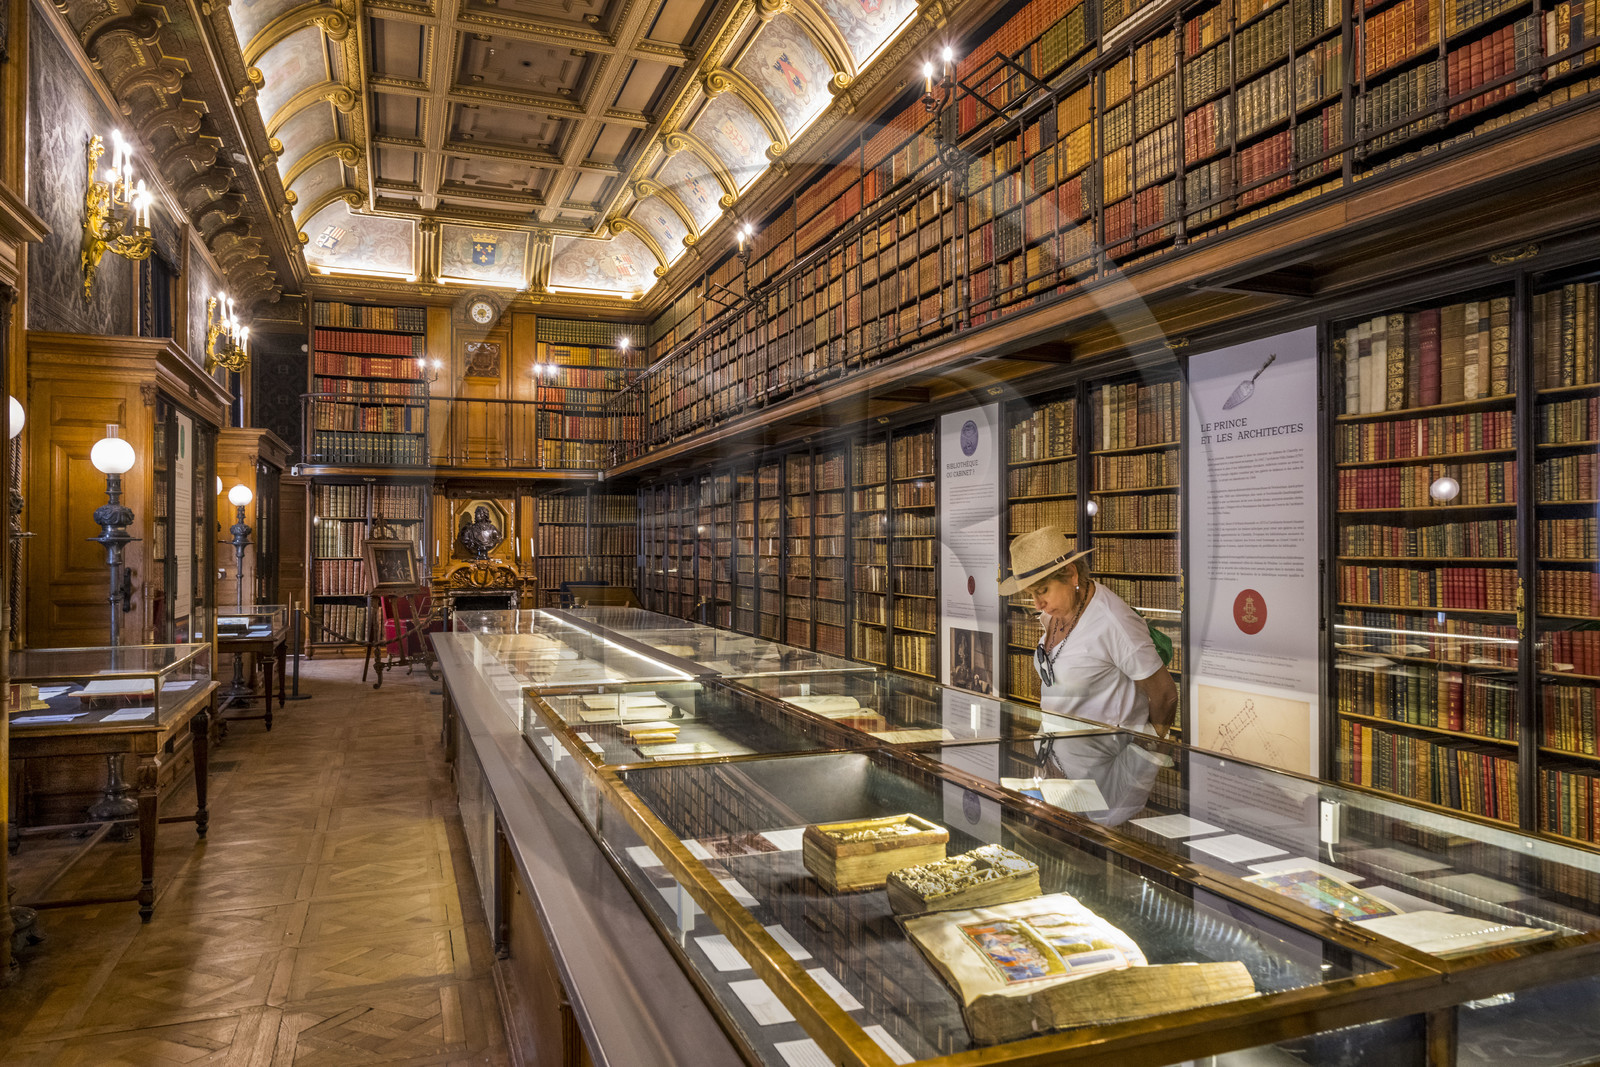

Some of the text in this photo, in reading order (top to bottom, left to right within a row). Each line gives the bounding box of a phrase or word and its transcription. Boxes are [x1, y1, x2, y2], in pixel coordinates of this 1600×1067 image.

[1201, 418, 1248, 433] LE PRINCE
[1201, 423, 1304, 445] ET LES ARCHITECTES
